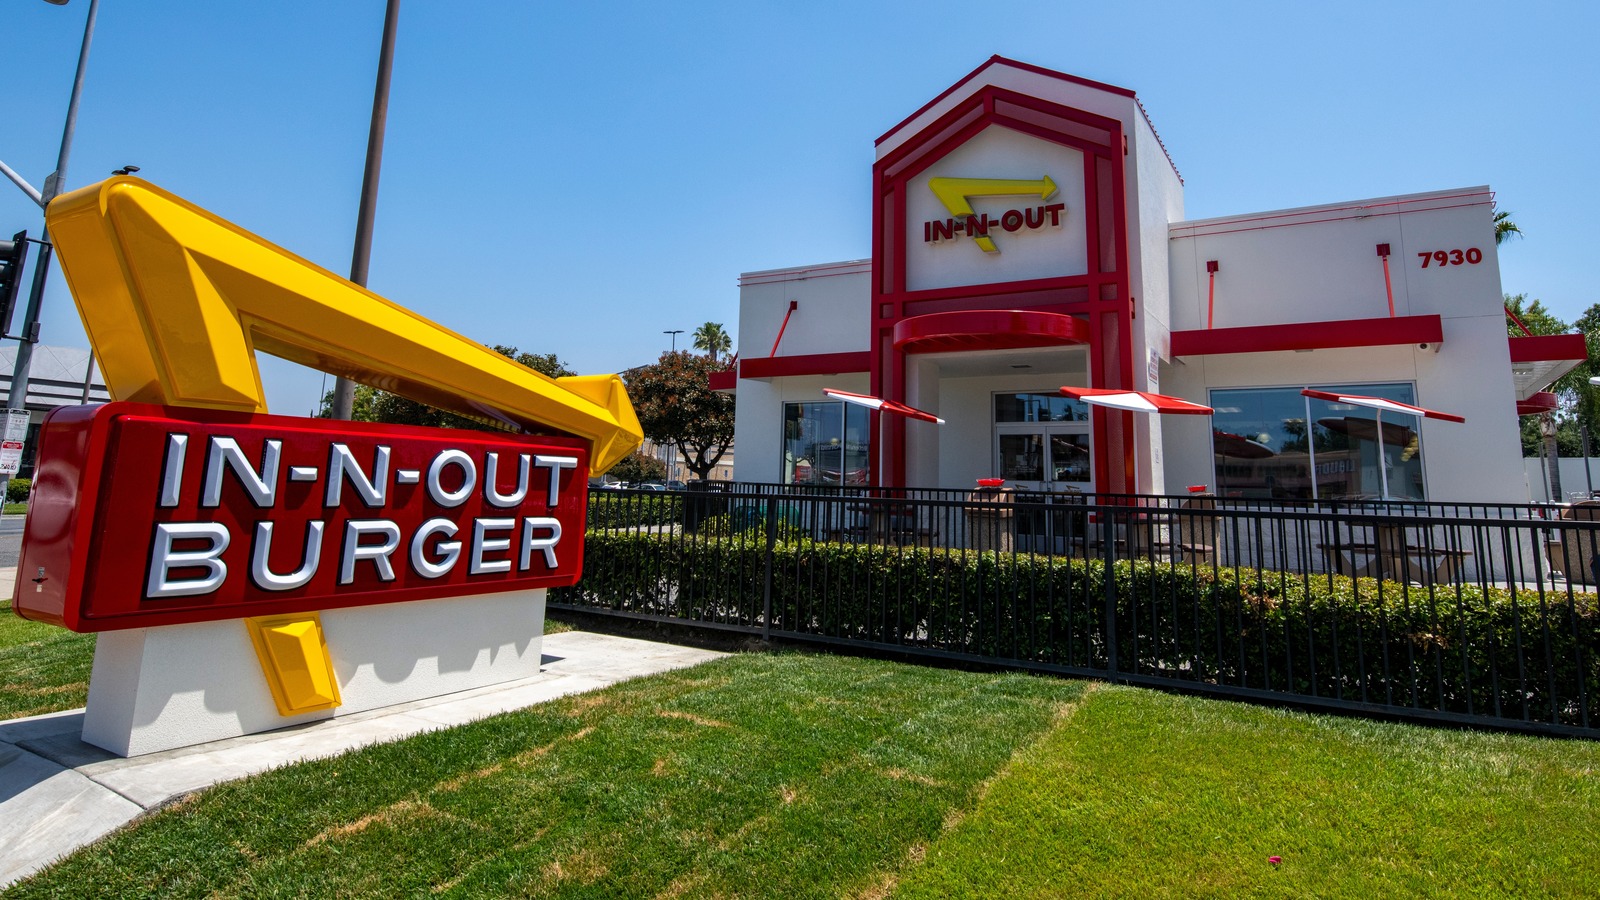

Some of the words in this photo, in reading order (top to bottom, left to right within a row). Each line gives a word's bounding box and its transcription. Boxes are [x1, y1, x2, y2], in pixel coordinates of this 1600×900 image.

[924, 203, 1066, 242] IN-N-OUT
[1417, 247, 1483, 269] 7930
[159, 432, 579, 508] IN-N-OUT
[146, 516, 563, 599] BURGER
